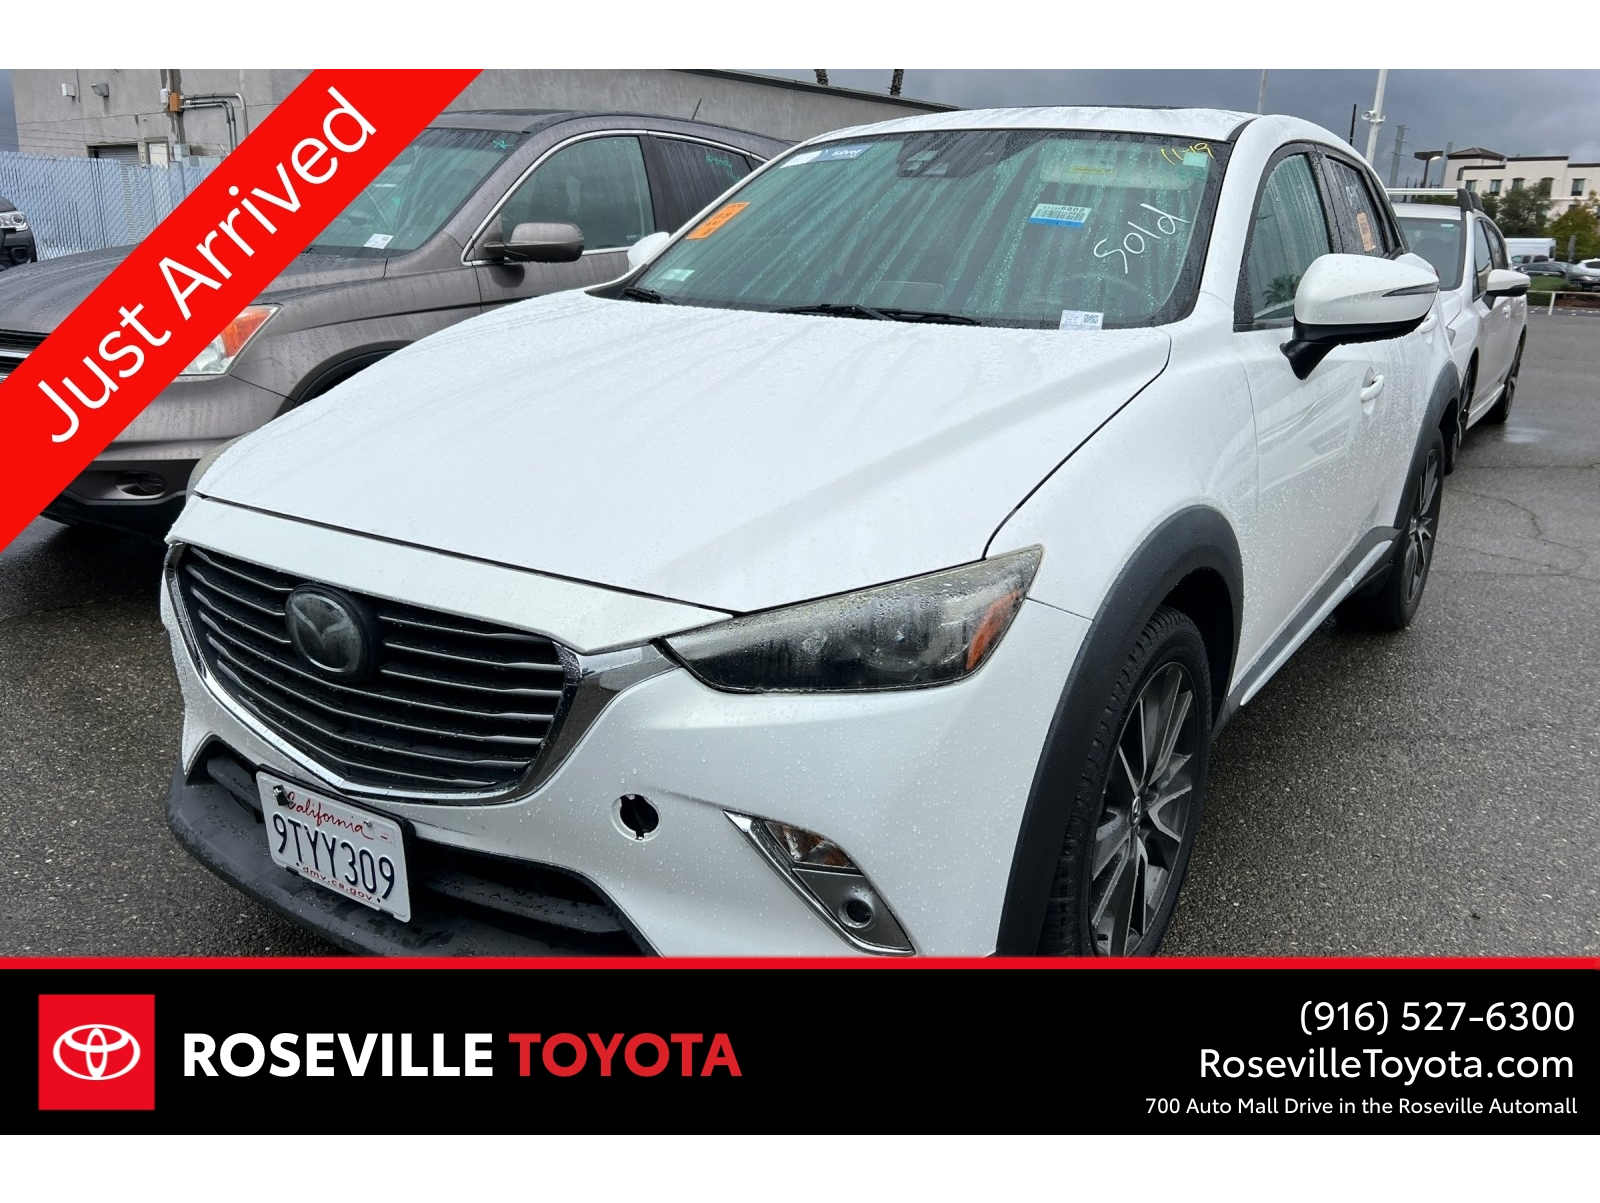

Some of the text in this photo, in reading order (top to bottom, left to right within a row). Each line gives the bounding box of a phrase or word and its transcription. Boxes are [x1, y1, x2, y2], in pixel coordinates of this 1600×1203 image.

[1093, 202, 1191, 275] Sold
[287, 791, 375, 841] California
[272, 813, 396, 900] 9TYY309
[302, 866, 373, 902] dmv.ca.gov
